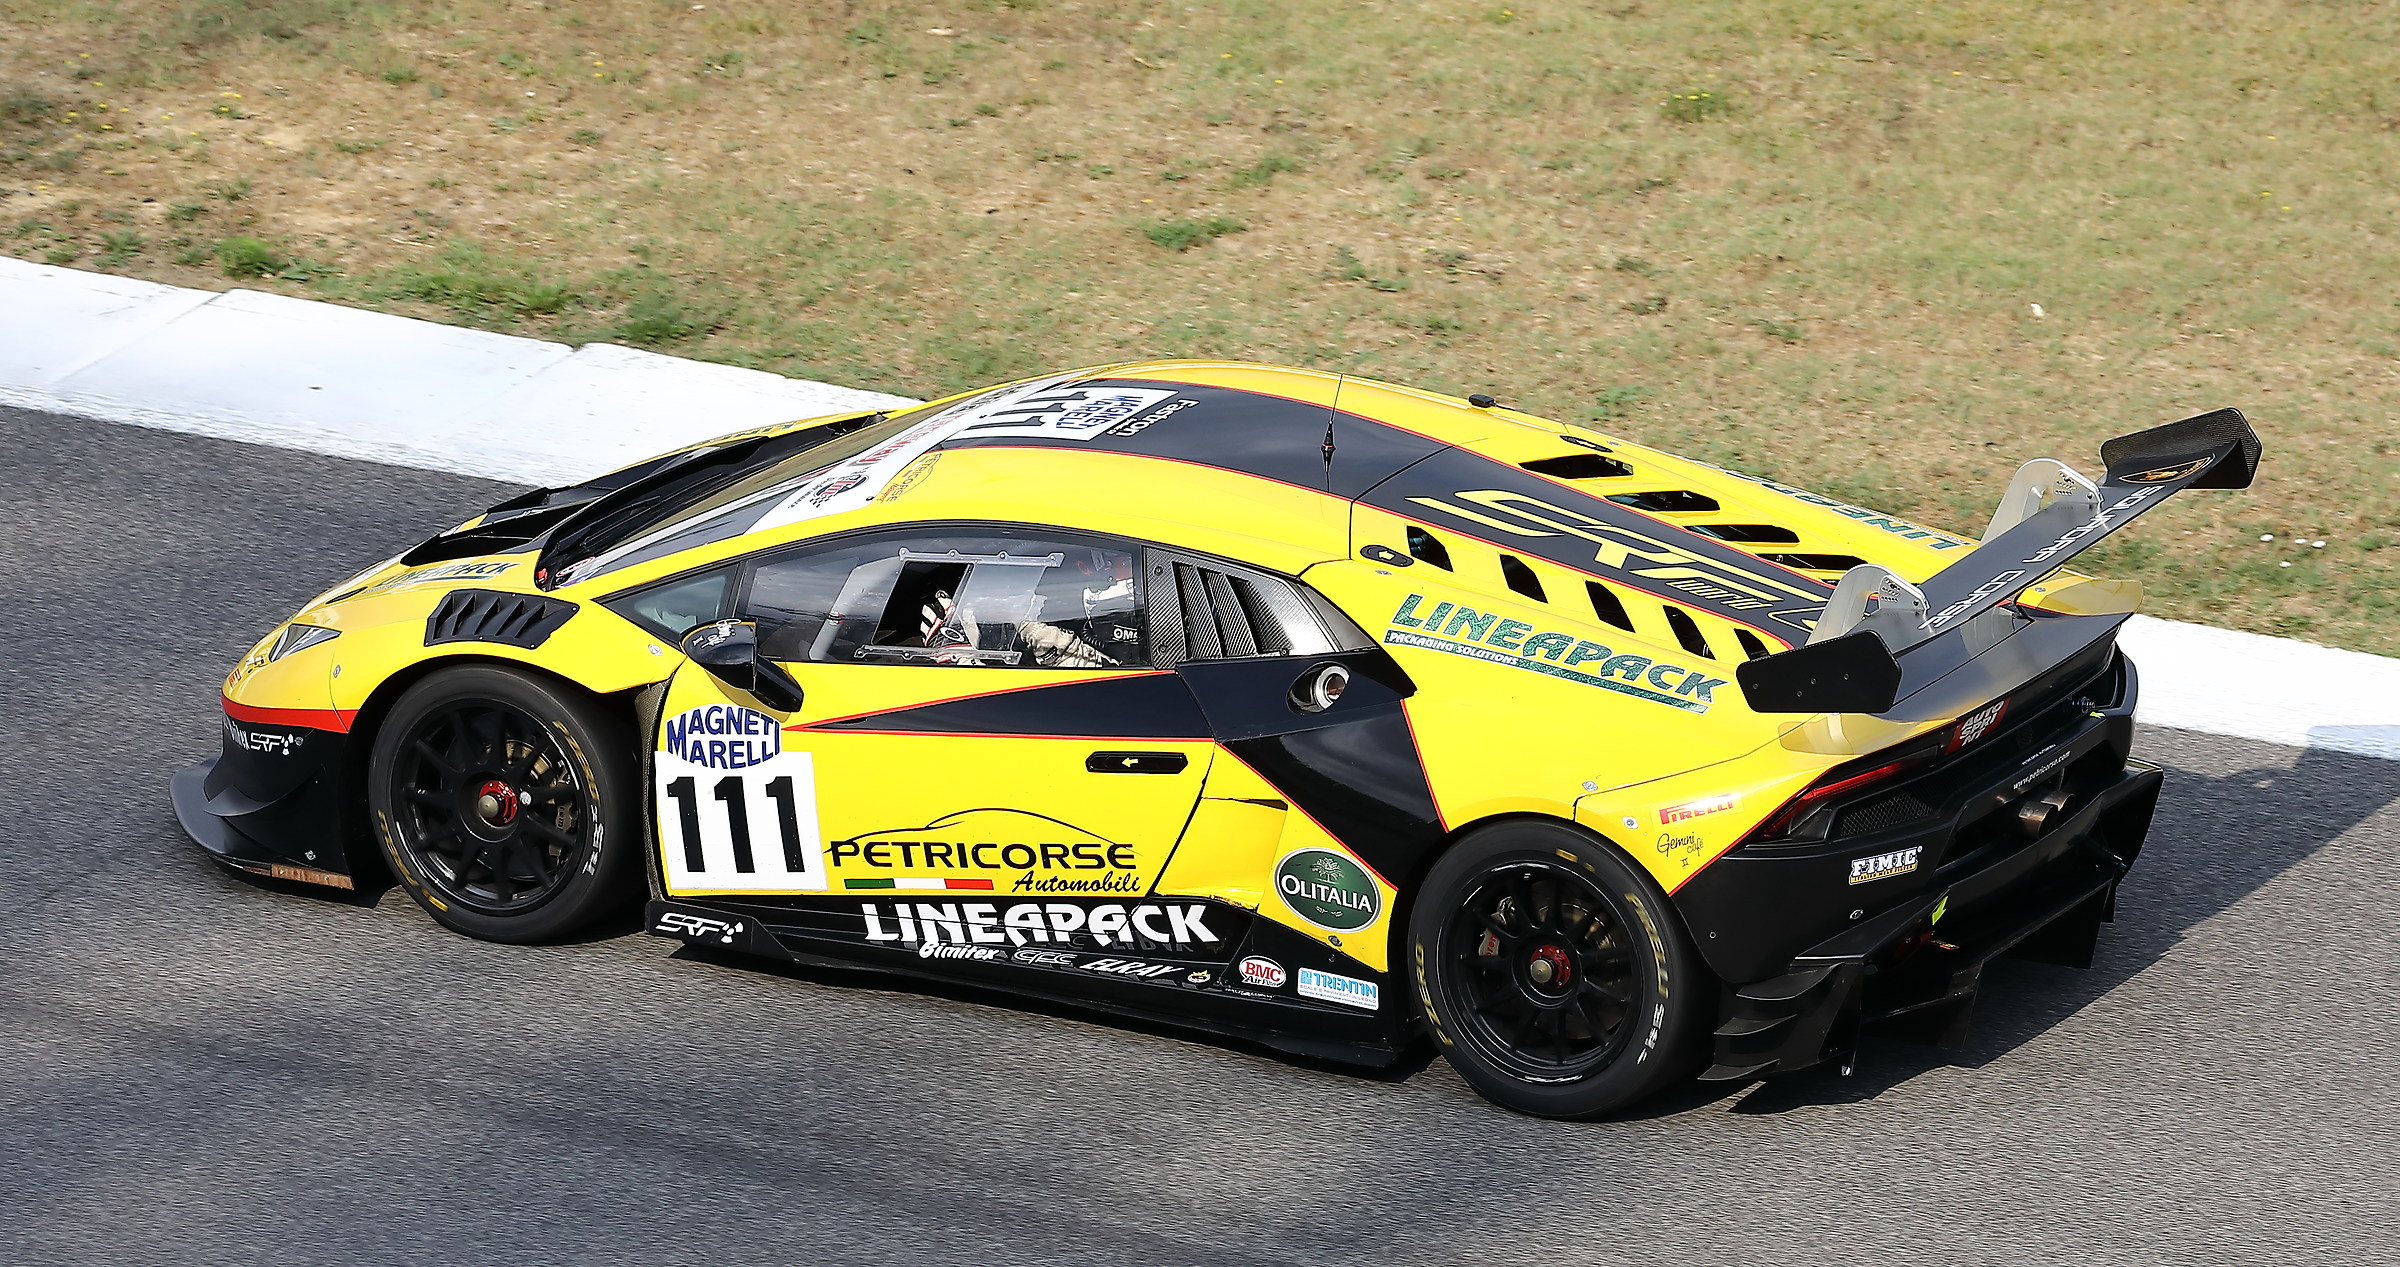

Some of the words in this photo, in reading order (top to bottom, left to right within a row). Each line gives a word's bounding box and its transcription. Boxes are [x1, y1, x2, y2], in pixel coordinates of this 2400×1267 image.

[1116, 399, 1200, 437] Fastron
[2022, 484, 2166, 563] SQUADRA
[1917, 569, 2026, 630] CORSE
[1389, 632, 1453, 652] PACKAGING
[1456, 643, 1519, 666] SOLUTIONS
[1391, 593, 1731, 703] LINEAPACK
[1961, 700, 2005, 730] AUTO
[250, 732, 283, 753] SRF
[667, 706, 780, 758] MAGNETI
[667, 714, 780, 769] MARELLI
[666, 776, 805, 873] 111
[1658, 793, 1734, 825] PIRELLI
[831, 840, 1137, 869] PETRICORSE
[1656, 831, 1695, 857] Gemini
[1852, 847, 1919, 877] FIMIC
[1011, 870, 1141, 892] Automobili
[1281, 874, 1373, 914] OLITALIA
[655, 912, 727, 937] SRF
[860, 903, 1220, 947] LINEAPACK
[1079, 958, 1186, 979] ELRAY
[1244, 961, 1281, 982] BMC
[1313, 972, 1377, 999] TRENTIN
